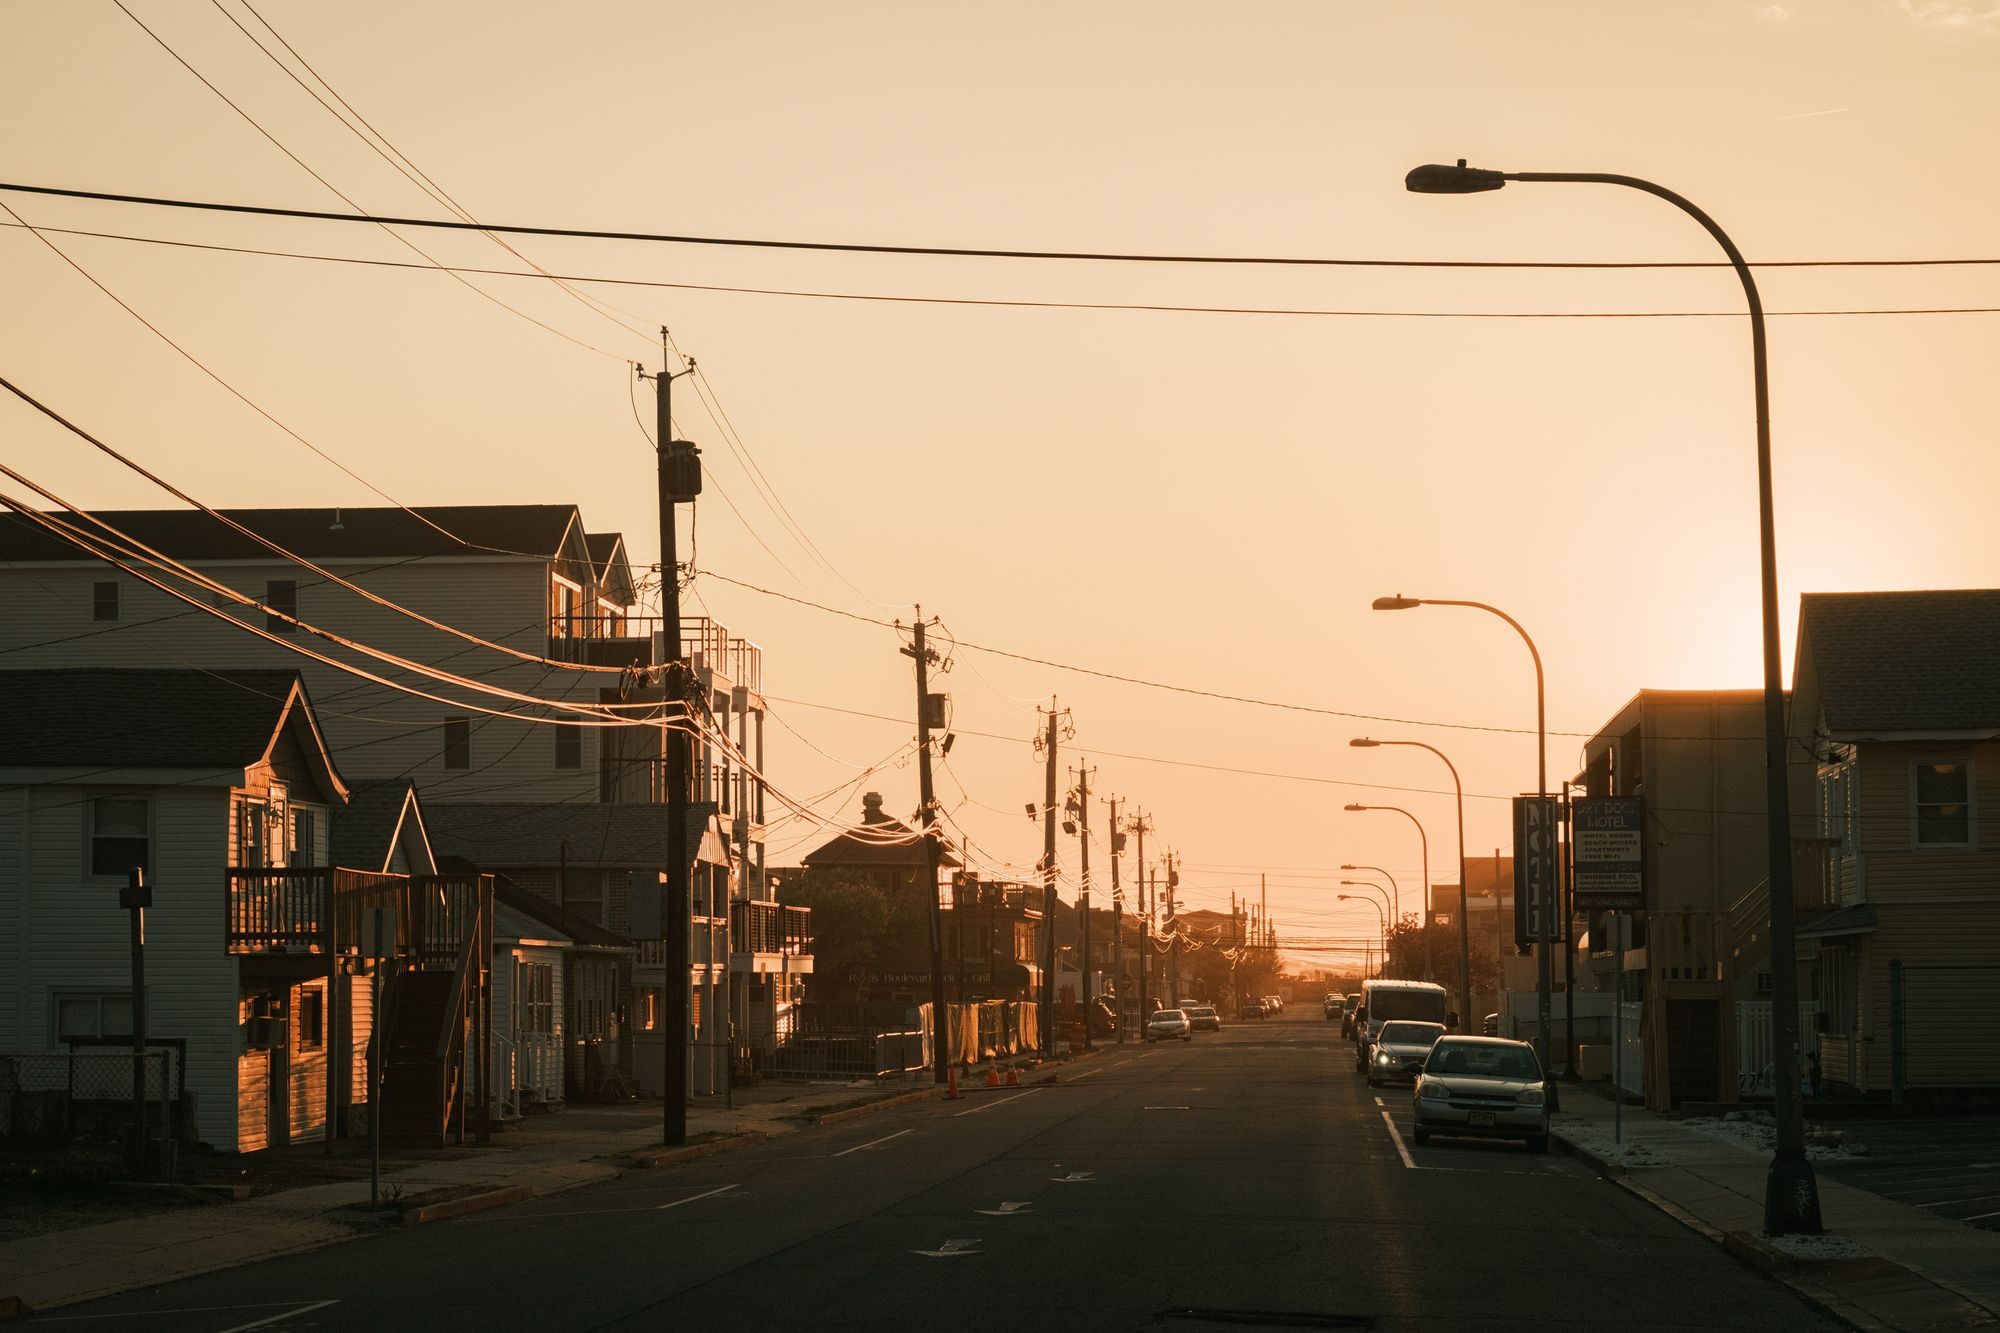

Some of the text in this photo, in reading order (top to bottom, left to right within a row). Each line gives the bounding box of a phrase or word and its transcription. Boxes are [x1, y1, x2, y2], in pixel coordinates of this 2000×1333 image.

[1587, 816, 1628, 828] MOTEL
[884, 972, 932, 983] Boulevard
[972, 972, 991, 983] Grill
